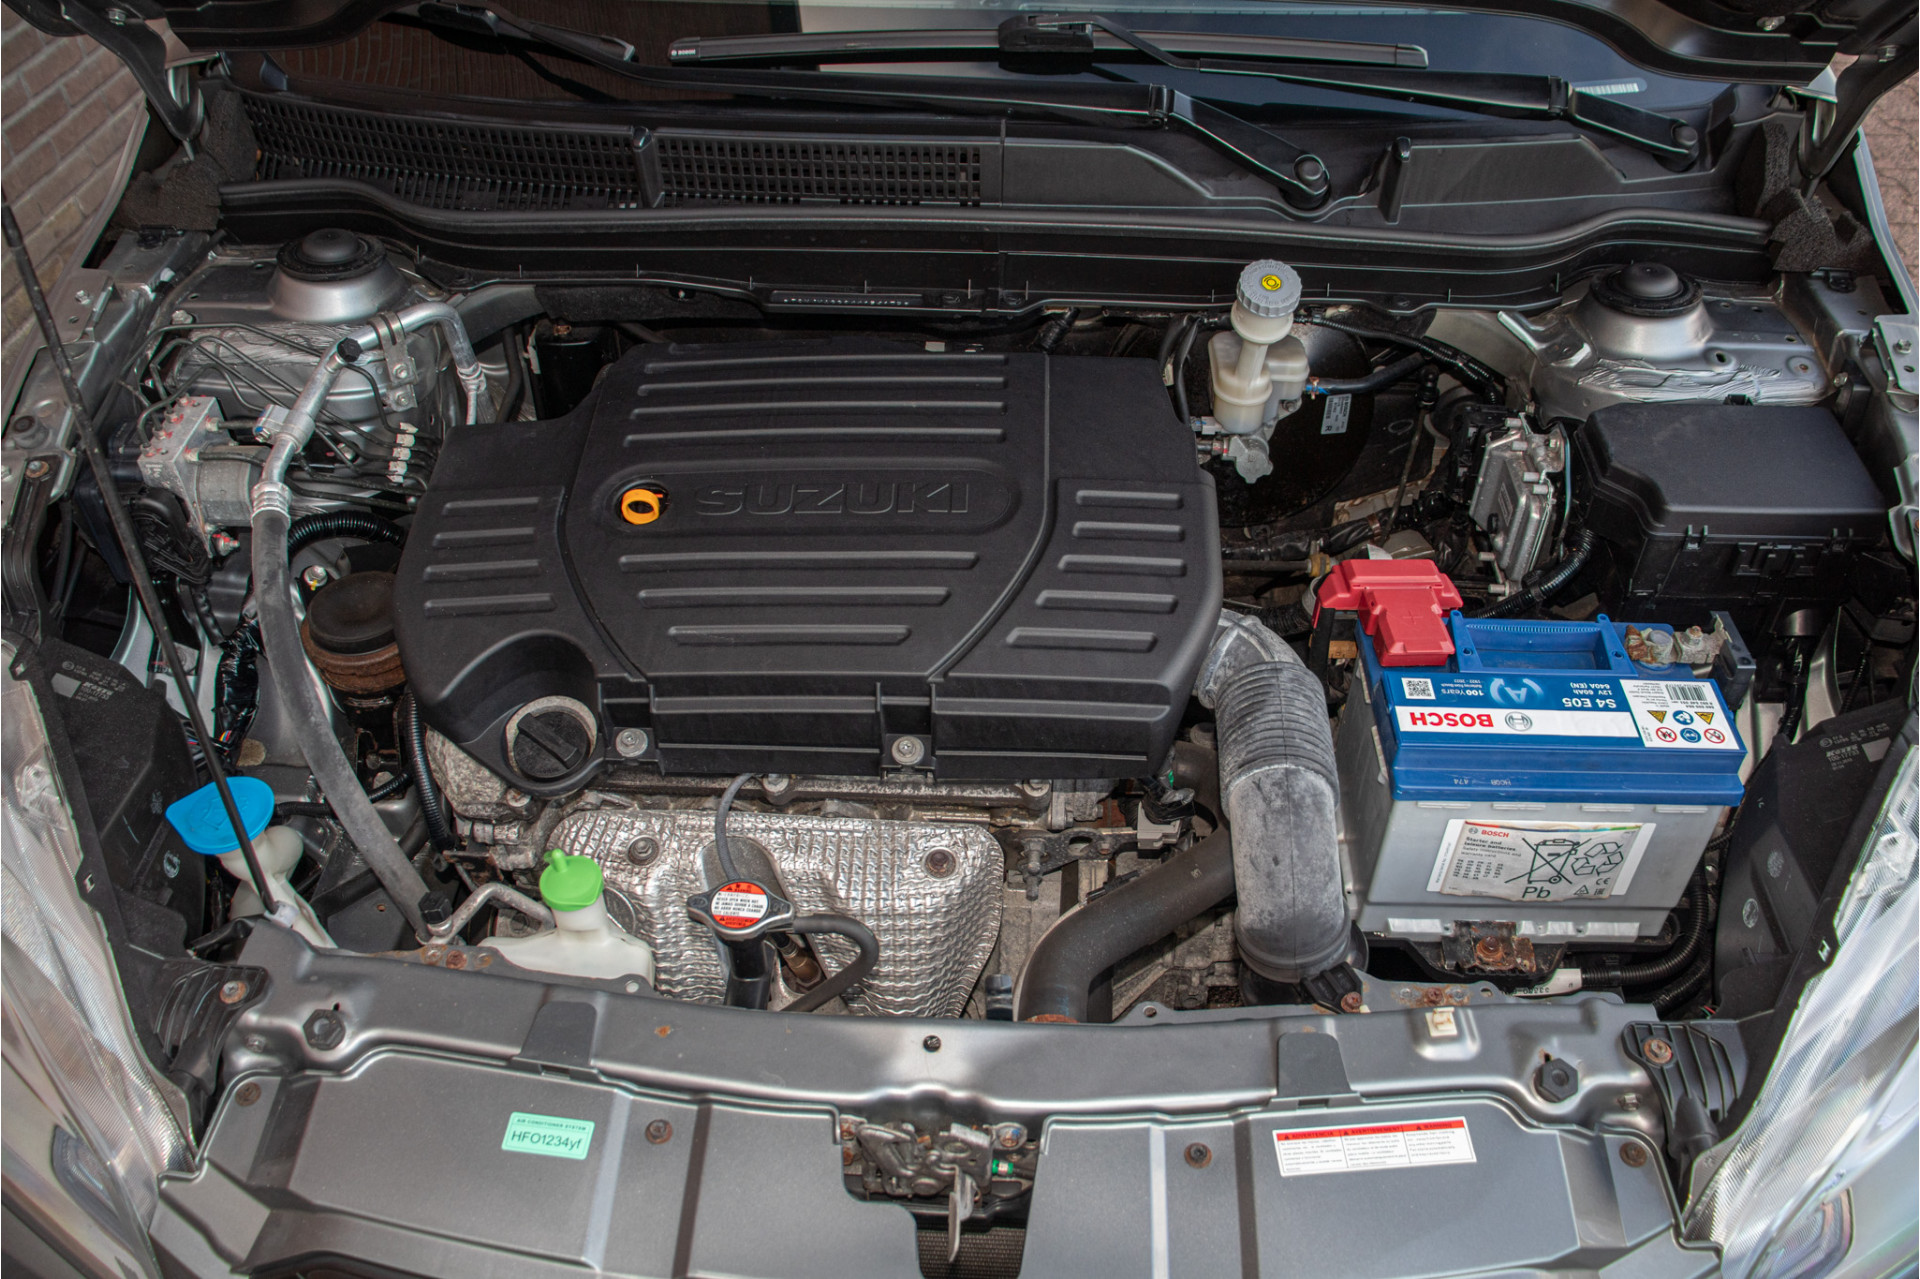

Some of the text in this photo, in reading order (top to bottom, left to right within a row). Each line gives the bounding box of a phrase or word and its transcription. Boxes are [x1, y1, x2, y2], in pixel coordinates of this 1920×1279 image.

[695, 482, 970, 516] SUZUKI
[1562, 697, 1617, 708] S4 E05
[1409, 712, 1494, 728] BOSCH
[1481, 829, 1510, 838] BOSCH
[1522, 886, 1551, 899] Pb
[511, 1130, 583, 1151] HFO1234yf
